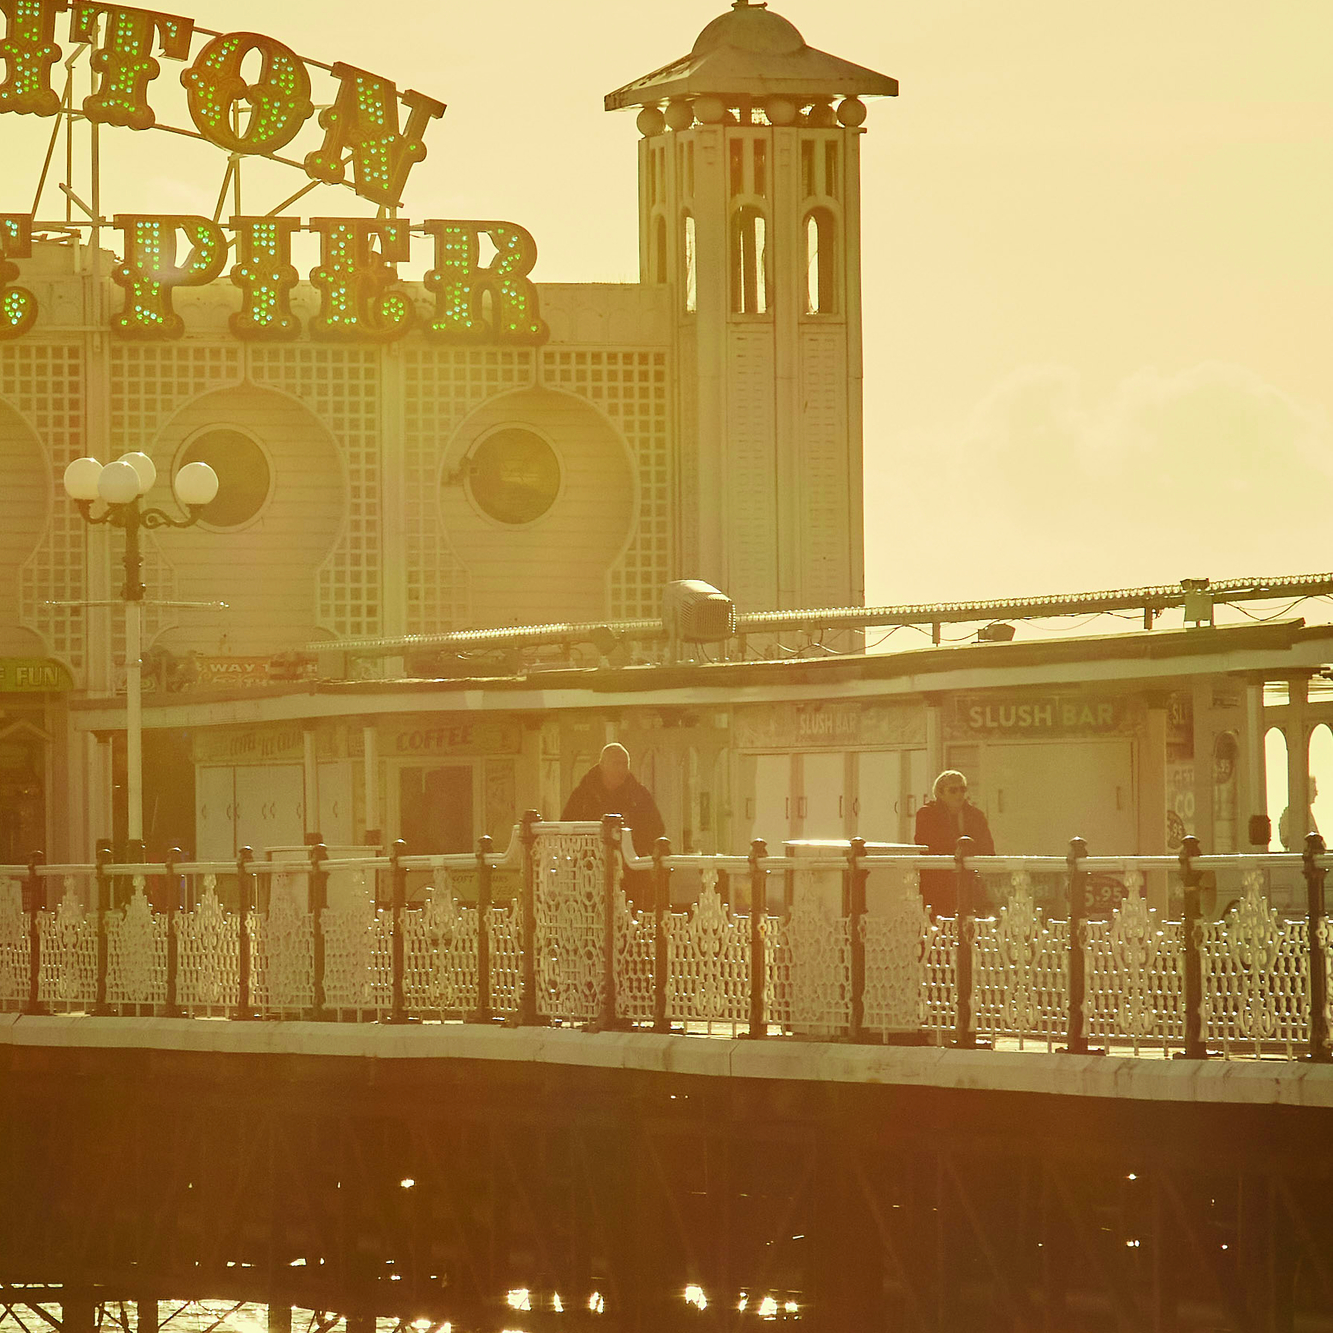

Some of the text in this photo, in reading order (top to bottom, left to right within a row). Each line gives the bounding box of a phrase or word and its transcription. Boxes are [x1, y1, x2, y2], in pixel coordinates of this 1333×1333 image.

[110, 213, 550, 347] PIER
[16, 667, 59, 687] FUN
[210, 663, 255, 673] WAY
[800, 712, 857, 735] SLUSH BAR
[969, 703, 1113, 728] SLUSH BAR
[396, 724, 474, 752] COFFEE
